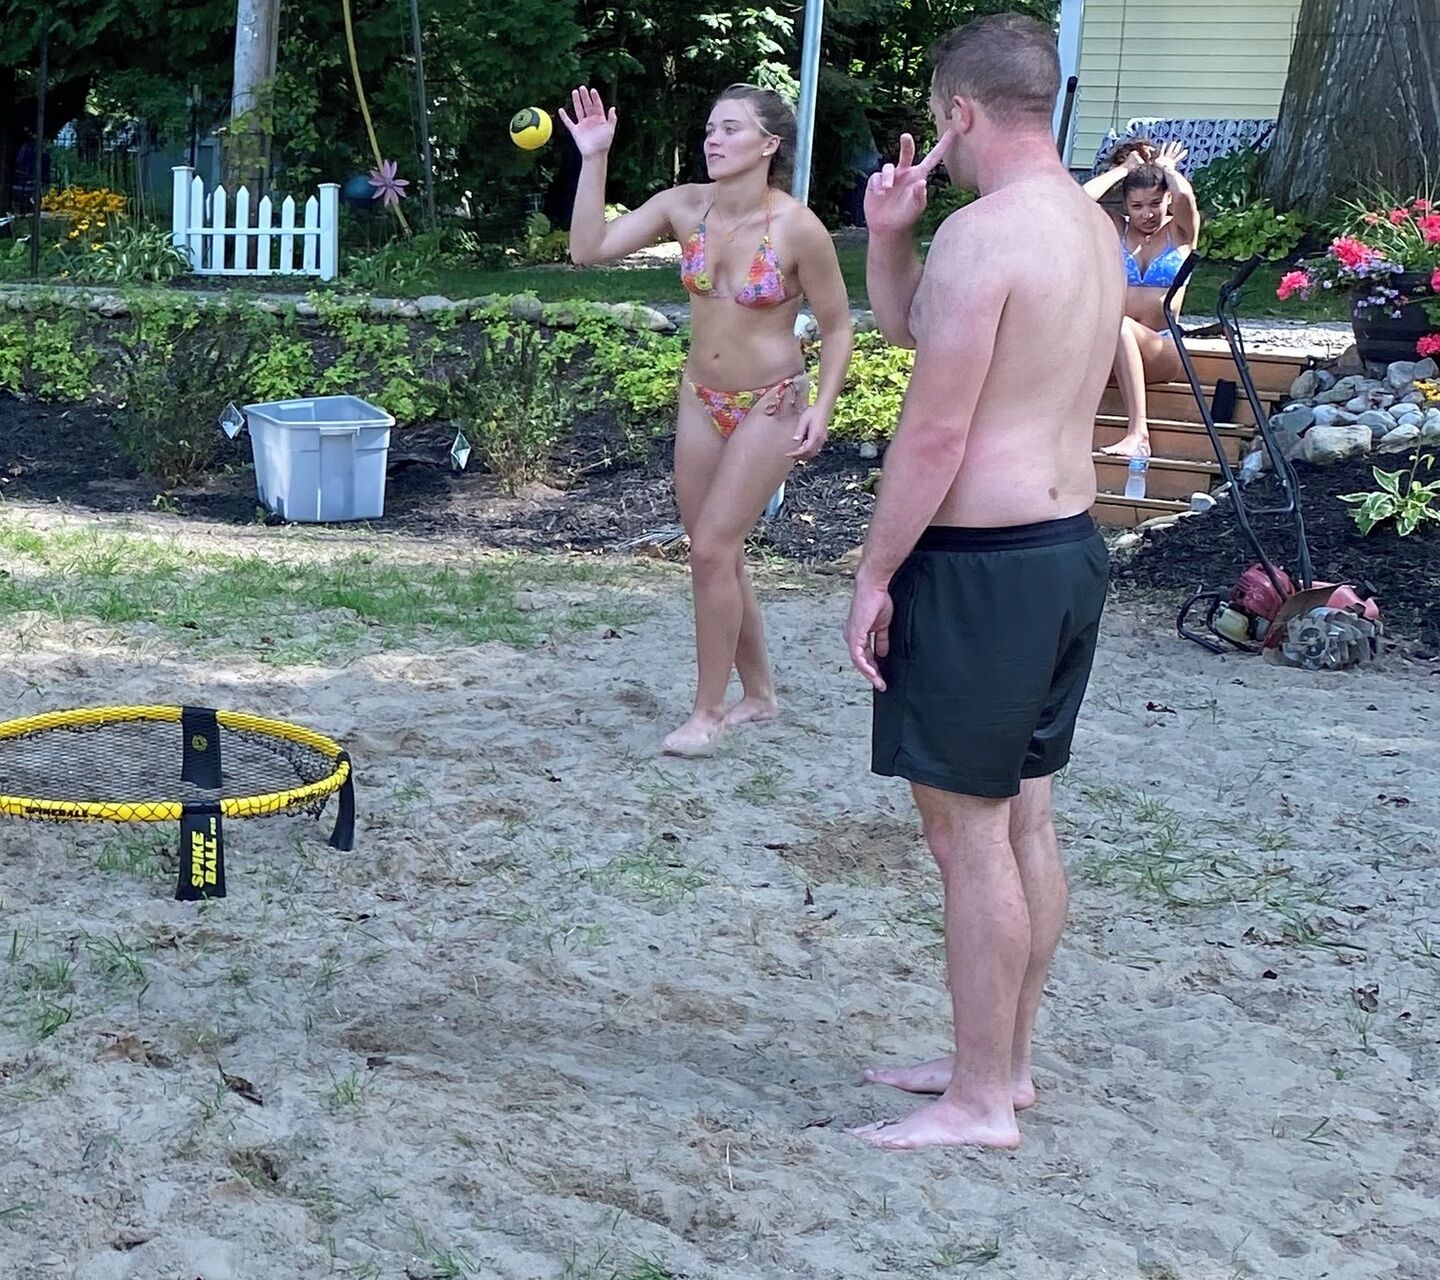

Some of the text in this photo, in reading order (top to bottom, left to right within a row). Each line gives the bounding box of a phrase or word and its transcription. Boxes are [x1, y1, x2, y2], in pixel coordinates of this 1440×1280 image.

[25, 806, 89, 818] SPIKEBALL
[191, 830, 205, 888] SPIKE
[205, 837, 218, 885] BALL
